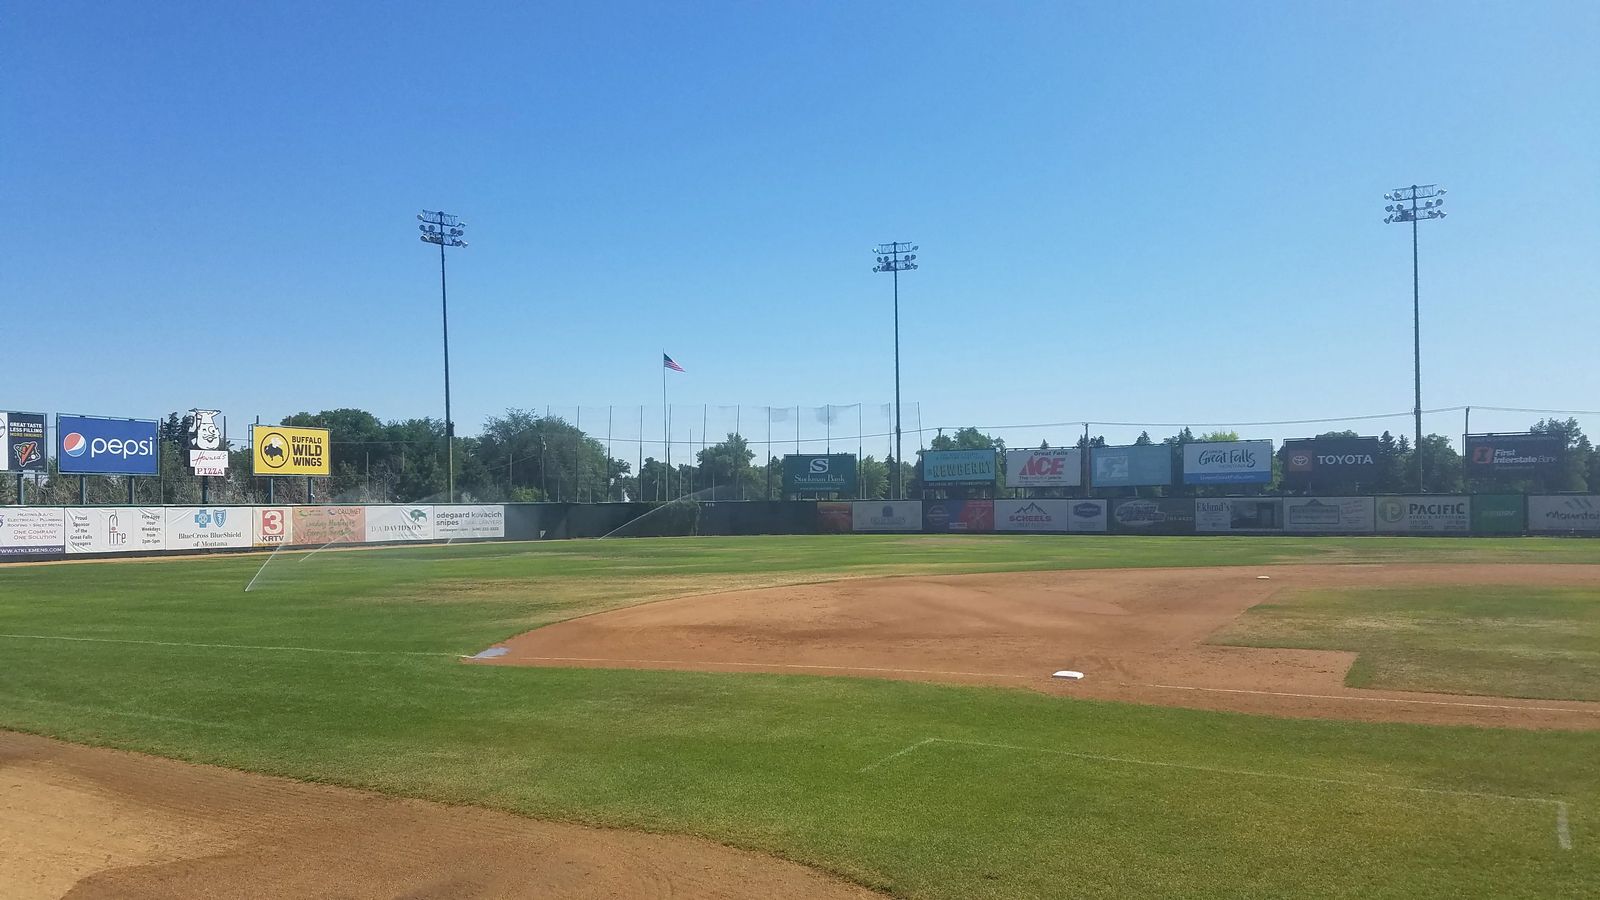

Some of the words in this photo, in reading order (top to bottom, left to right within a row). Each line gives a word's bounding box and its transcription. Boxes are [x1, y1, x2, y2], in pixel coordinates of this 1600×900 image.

[291, 435, 322, 444] BUFFALO
[91, 436, 153, 459] pepsi
[292, 443, 322, 457] WILD
[1495, 449, 1516, 457] First
[292, 456, 322, 467] WINGS
[1198, 450, 1227, 466] Great
[1229, 449, 1256, 468] Falls
[1317, 454, 1374, 465] TOYOTA
[1493, 455, 1538, 464] Interstate
[1537, 455, 1558, 463] Bank
[932, 460, 991, 478] NEWBERRY
[1019, 455, 1066, 476] ACE
[196, 467, 224, 475] PIZZA
[794, 473, 826, 482] Stockman
[827, 473, 845, 482] Bank
[1196, 502, 1231, 513] Eklund's
[1408, 502, 1466, 515] PACIFIC
[436, 511, 470, 520] odegaard
[1008, 514, 1052, 522] SCHEELS
[264, 510, 284, 535] 3
[436, 519, 460, 527] snipes
[384, 524, 423, 532] DAVIDSON
[178, 532, 210, 540] BlueCross
[210, 531, 242, 539] BlueShield
